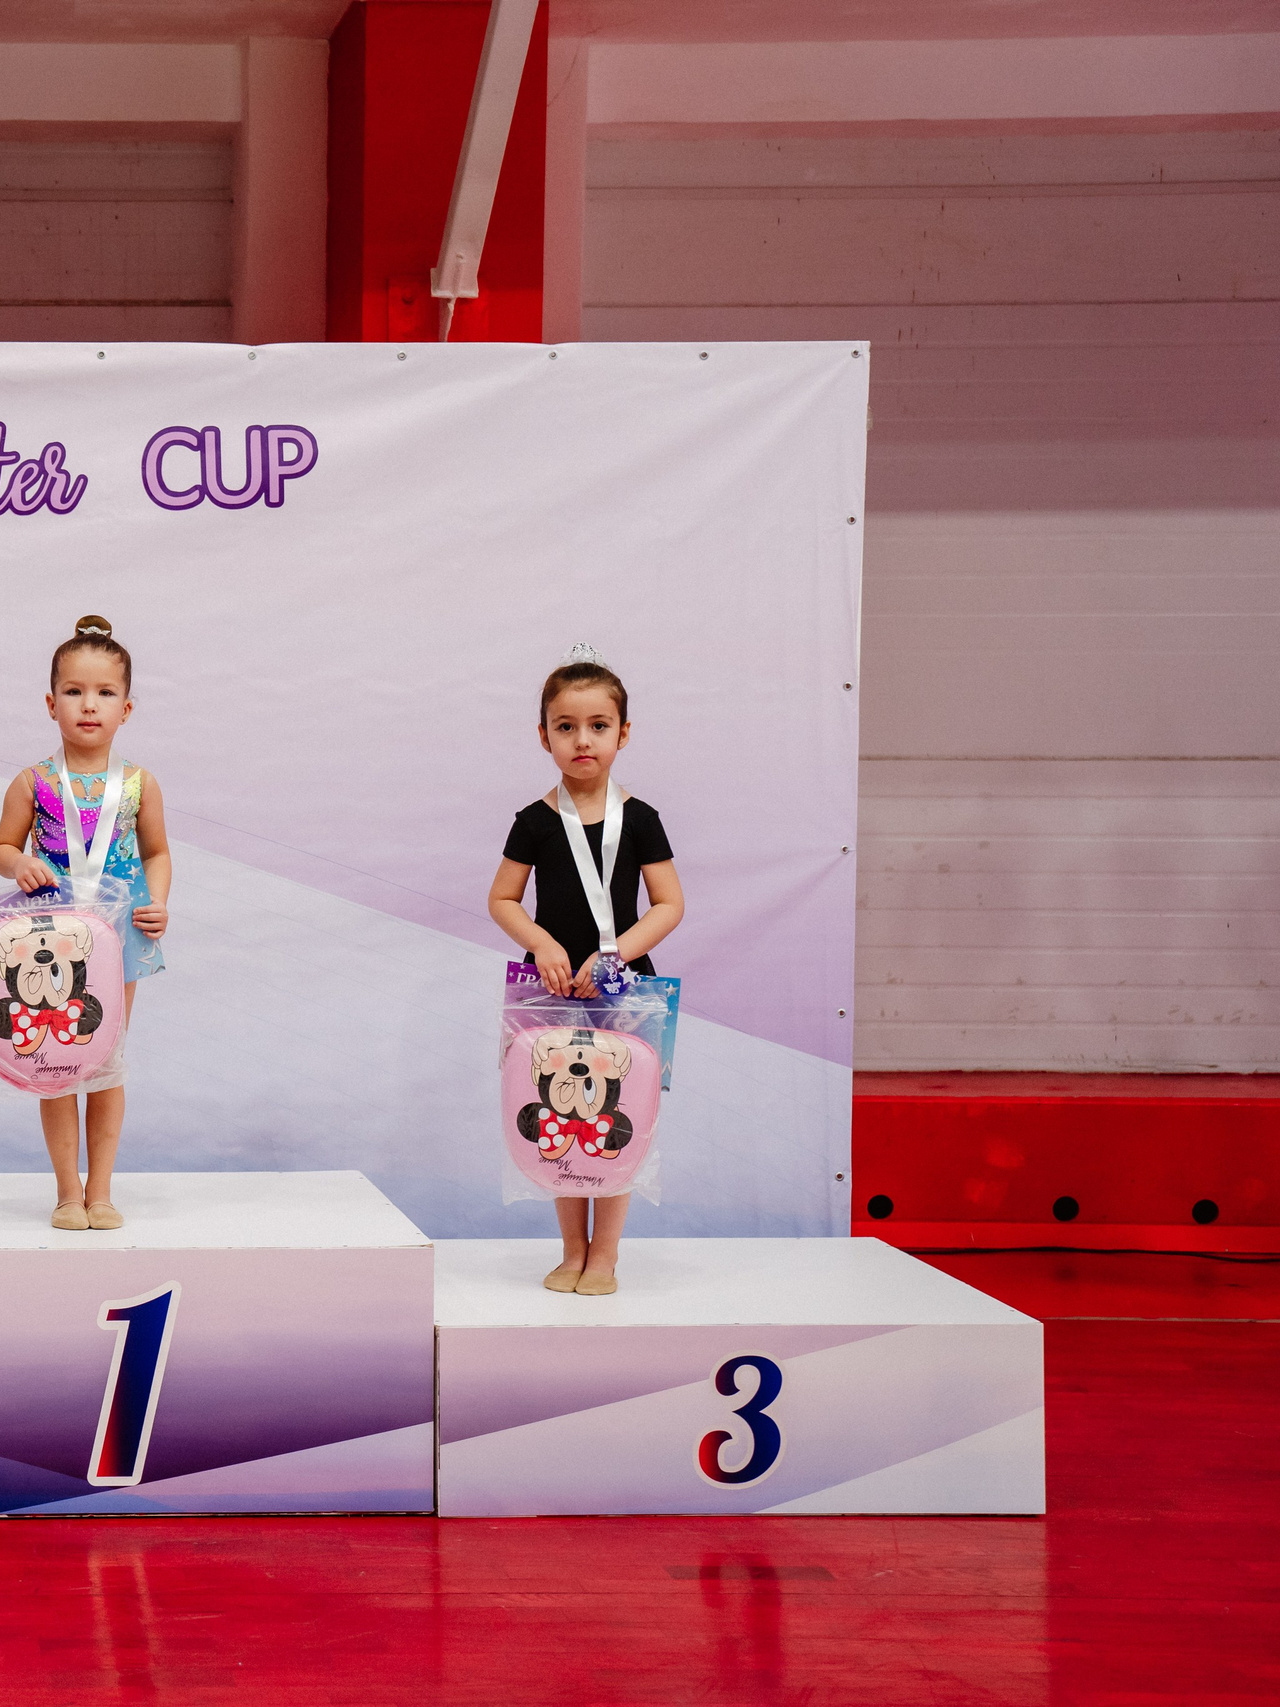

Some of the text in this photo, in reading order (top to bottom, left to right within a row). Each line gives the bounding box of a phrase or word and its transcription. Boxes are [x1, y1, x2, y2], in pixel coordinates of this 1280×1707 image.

[141, 424, 318, 511] CUP
[86, 1280, 182, 1487] 1
[692, 1349, 790, 1491] 3
